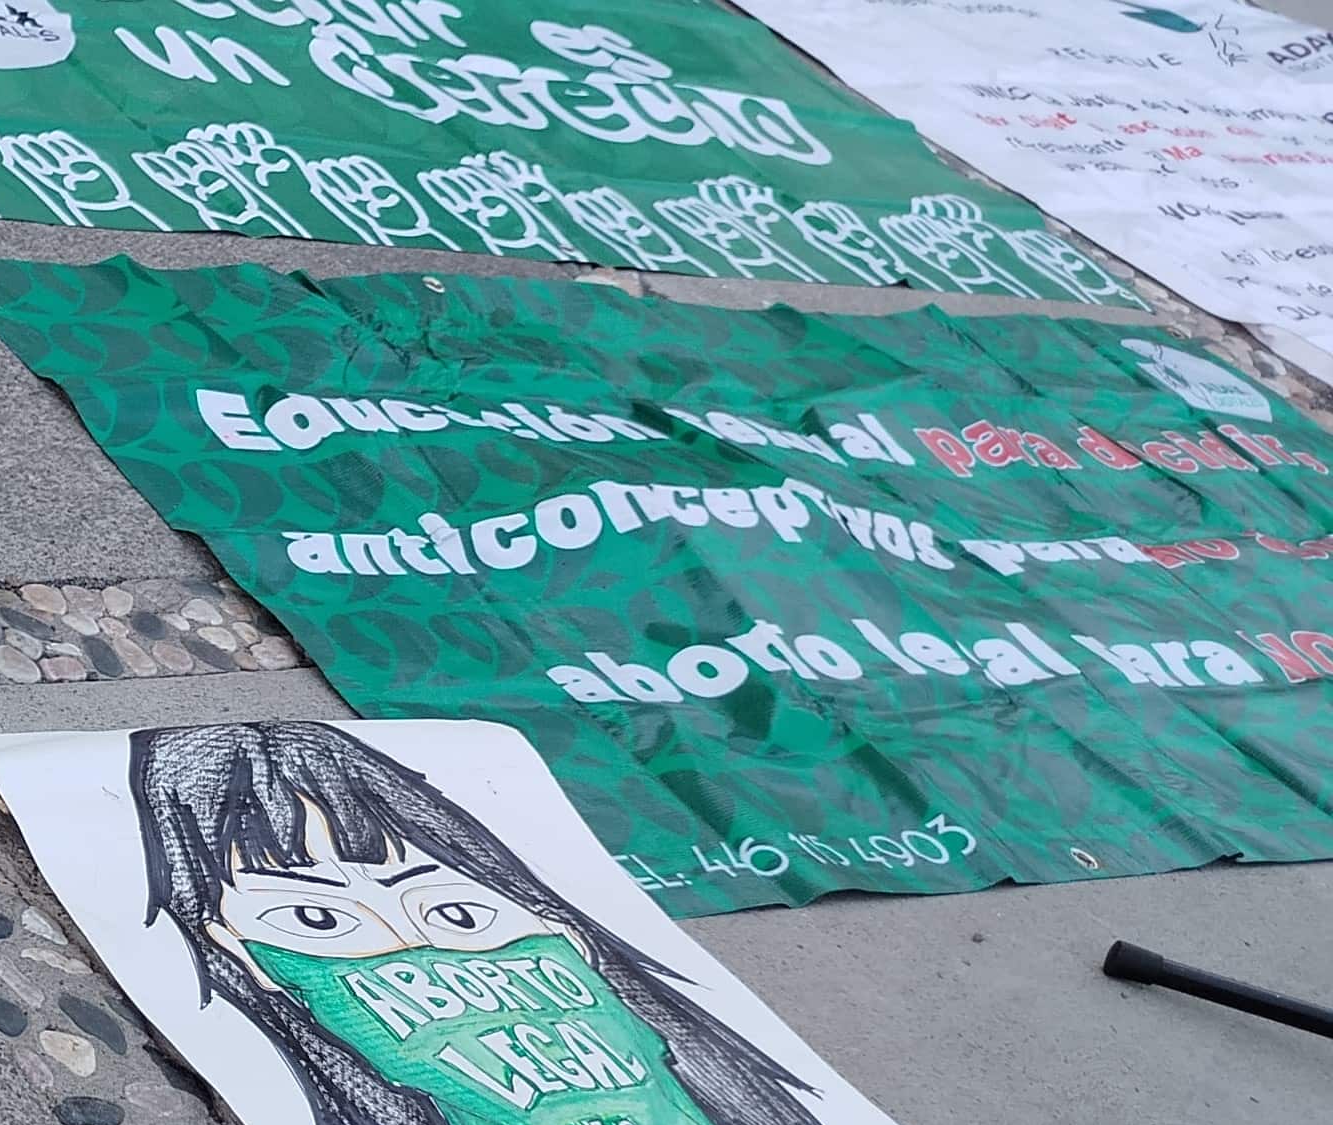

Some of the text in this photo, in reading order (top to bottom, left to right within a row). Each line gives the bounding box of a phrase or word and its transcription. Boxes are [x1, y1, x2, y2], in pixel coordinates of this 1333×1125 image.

[114, 26, 290, 86] un
[530, 20, 673, 78] es
[913, 420, 1083, 478] para
[1077, 424, 1329, 475] dcidir,
[281, 478, 956, 575] anticoncepvos
[851, 619, 1081, 688] leal
[612, 813, 977, 890] EL: 446 115 4903
[341, 955, 598, 1042] ABORTO
[435, 1018, 650, 1111] LEGAL
